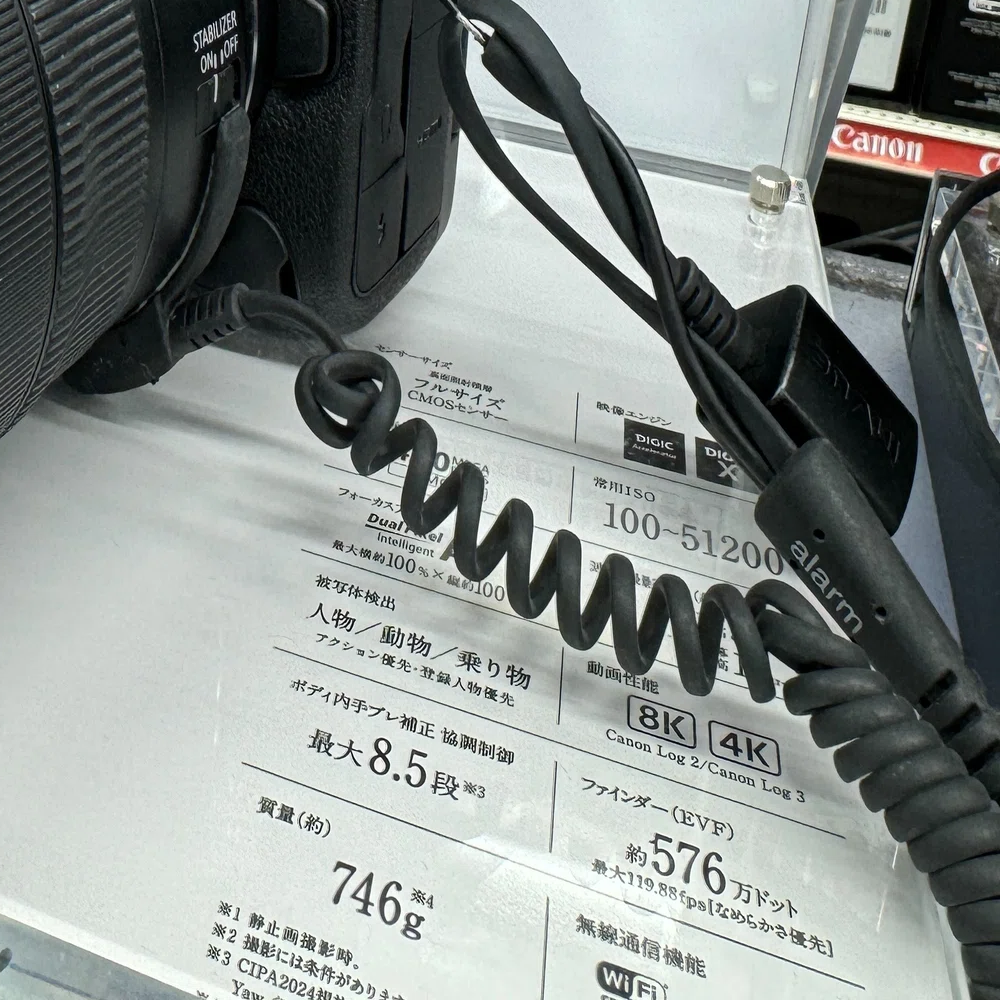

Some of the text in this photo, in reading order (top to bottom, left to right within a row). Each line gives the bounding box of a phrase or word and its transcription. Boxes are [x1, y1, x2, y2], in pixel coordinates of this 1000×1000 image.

[193, 10, 237, 53] STABILIZER
[200, 34, 239, 74] ON OFF
[831, 124, 923, 163] Canon
[408, 390, 508, 421] CMOSセンサー
[415, 378, 505, 410] フルサイズ
[635, 433, 674, 451] DIGIC
[593, 476, 656, 502] 常用ISO
[367, 513, 403, 532] Dual
[377, 532, 434, 558] Intelligent
[315, 573, 396, 611] 被写体検出
[790, 540, 863, 635] alarm
[290, 679, 435, 739] ボディ内手ブレ補正
[638, 705, 686, 741] 8K
[606, 728, 652, 753] Canon
[656, 744, 686, 766] Log
[761, 777, 791, 802] Log
[796, 790, 806, 803] 3
[719, 732, 770, 768] 4K
[625, 832, 799, 919] 約576万ドット
[576, 914, 707, 979] 無線通信機能
